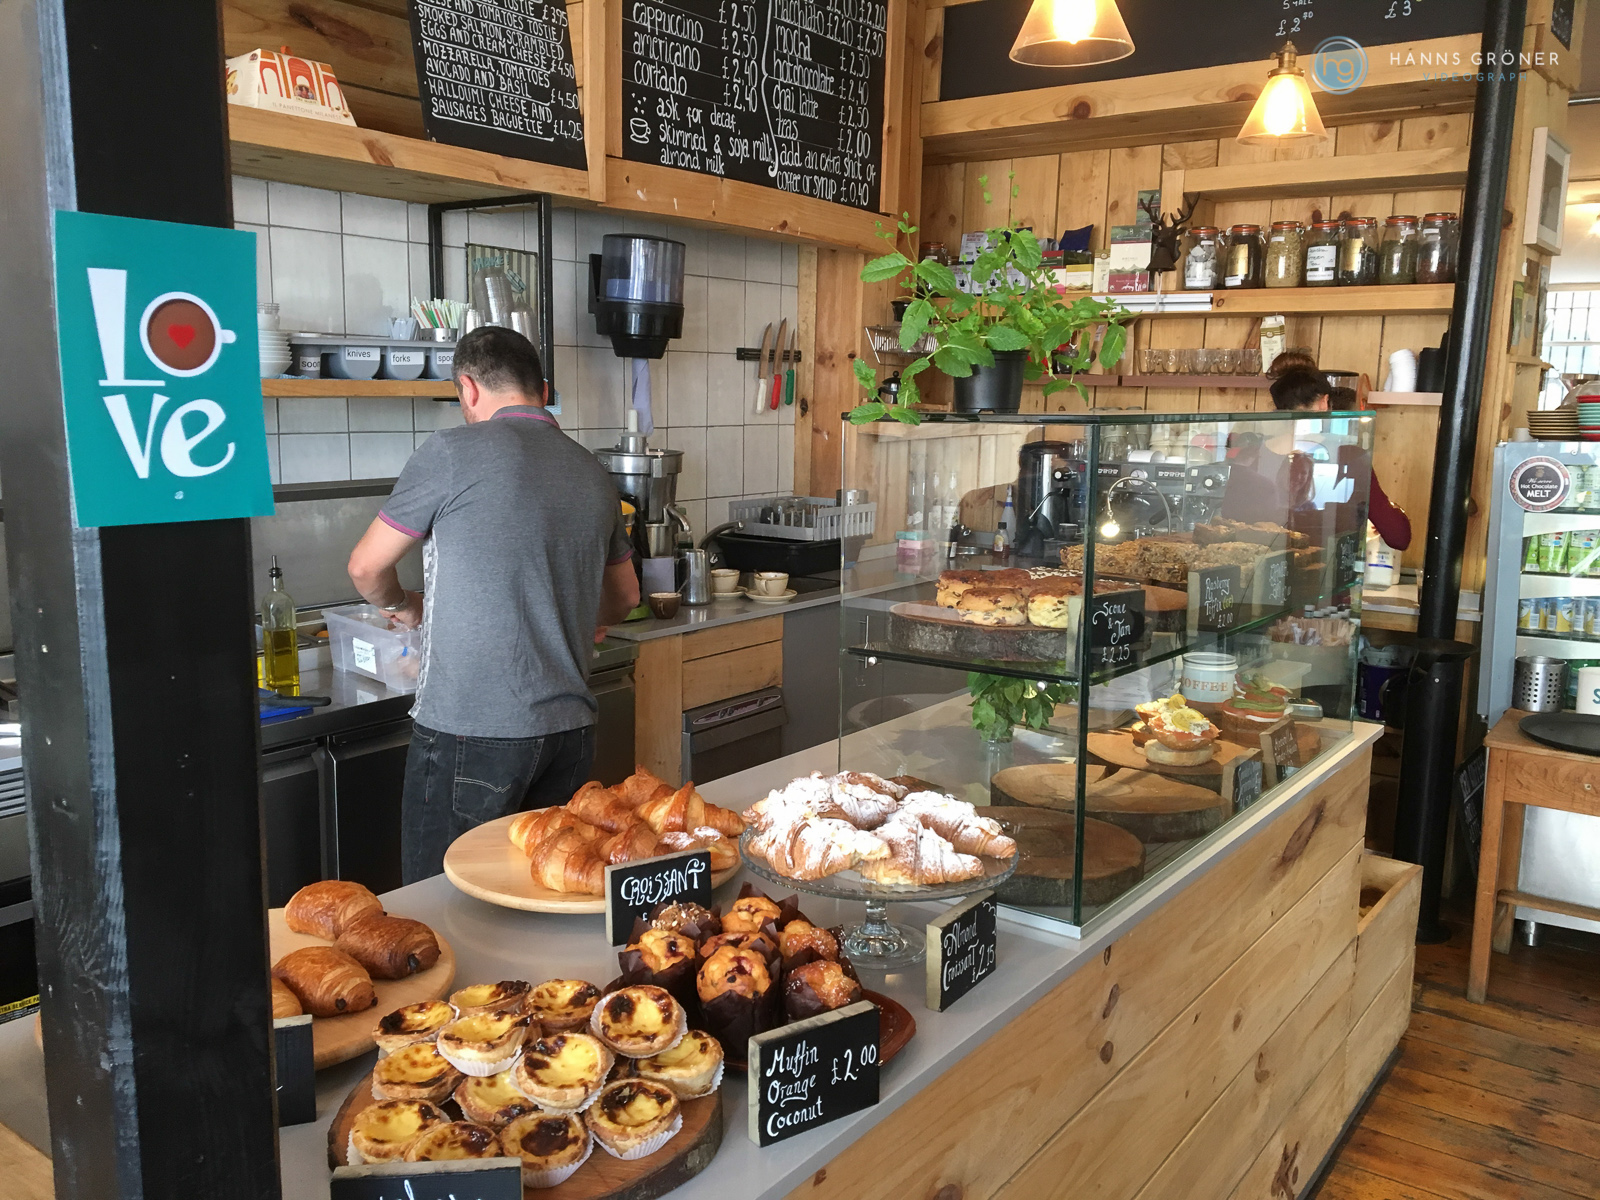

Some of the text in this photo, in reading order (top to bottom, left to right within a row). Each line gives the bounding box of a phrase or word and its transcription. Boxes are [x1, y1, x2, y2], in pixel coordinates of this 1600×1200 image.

[418, 4, 458, 27] SMOKED
[505, 29, 564, 61] SCRAMBLED
[476, 2, 523, 30] TOMATOES
[526, 19, 558, 41] TOSTIE
[632, 2, 704, 43] cappuccino
[420, 18, 447, 40] EGGS
[449, 27, 470, 45] AND
[471, 33, 508, 57] CREAM
[510, 45, 547, 70] CHEESE
[633, 31, 701, 72] americano
[775, 23, 812, 61] mocha
[426, 57, 471, 82] AVOCADO
[474, 68, 495, 88] AND
[498, 60, 550, 88] TOMATOES
[633, 60, 688, 96] cortado
[278, 103, 313, 115] PANETTONE
[428, 77, 552, 123] HALLOUMI CHEESE AND
[431, 96, 487, 122] SAUSAGES
[492, 108, 543, 135] BAGUETTE
[656, 94, 680, 121] ask
[686, 106, 703, 128] for
[799, 86, 819, 119] latte
[658, 119, 707, 152] skimmed
[713, 134, 723, 156] &
[775, 109, 799, 140] teas
[660, 144, 725, 175] almond milk
[780, 140, 877, 186] add an extra shot of
[776, 170, 801, 193] coffee
[802, 174, 812, 194] or
[812, 175, 837, 202] syrup
[347, 348, 371, 358] knives
[392, 354, 411, 363] forks
[1526, 489, 1552, 498] MELT
[1092, 601, 1127, 625] Scone
[1101, 643, 1130, 663] £2.25
[943, 910, 978, 957] Almond
[765, 1039, 877, 1086] Muffin £2.00
[767, 1074, 817, 1108] Orange
[766, 1095, 824, 1137] Coconut
